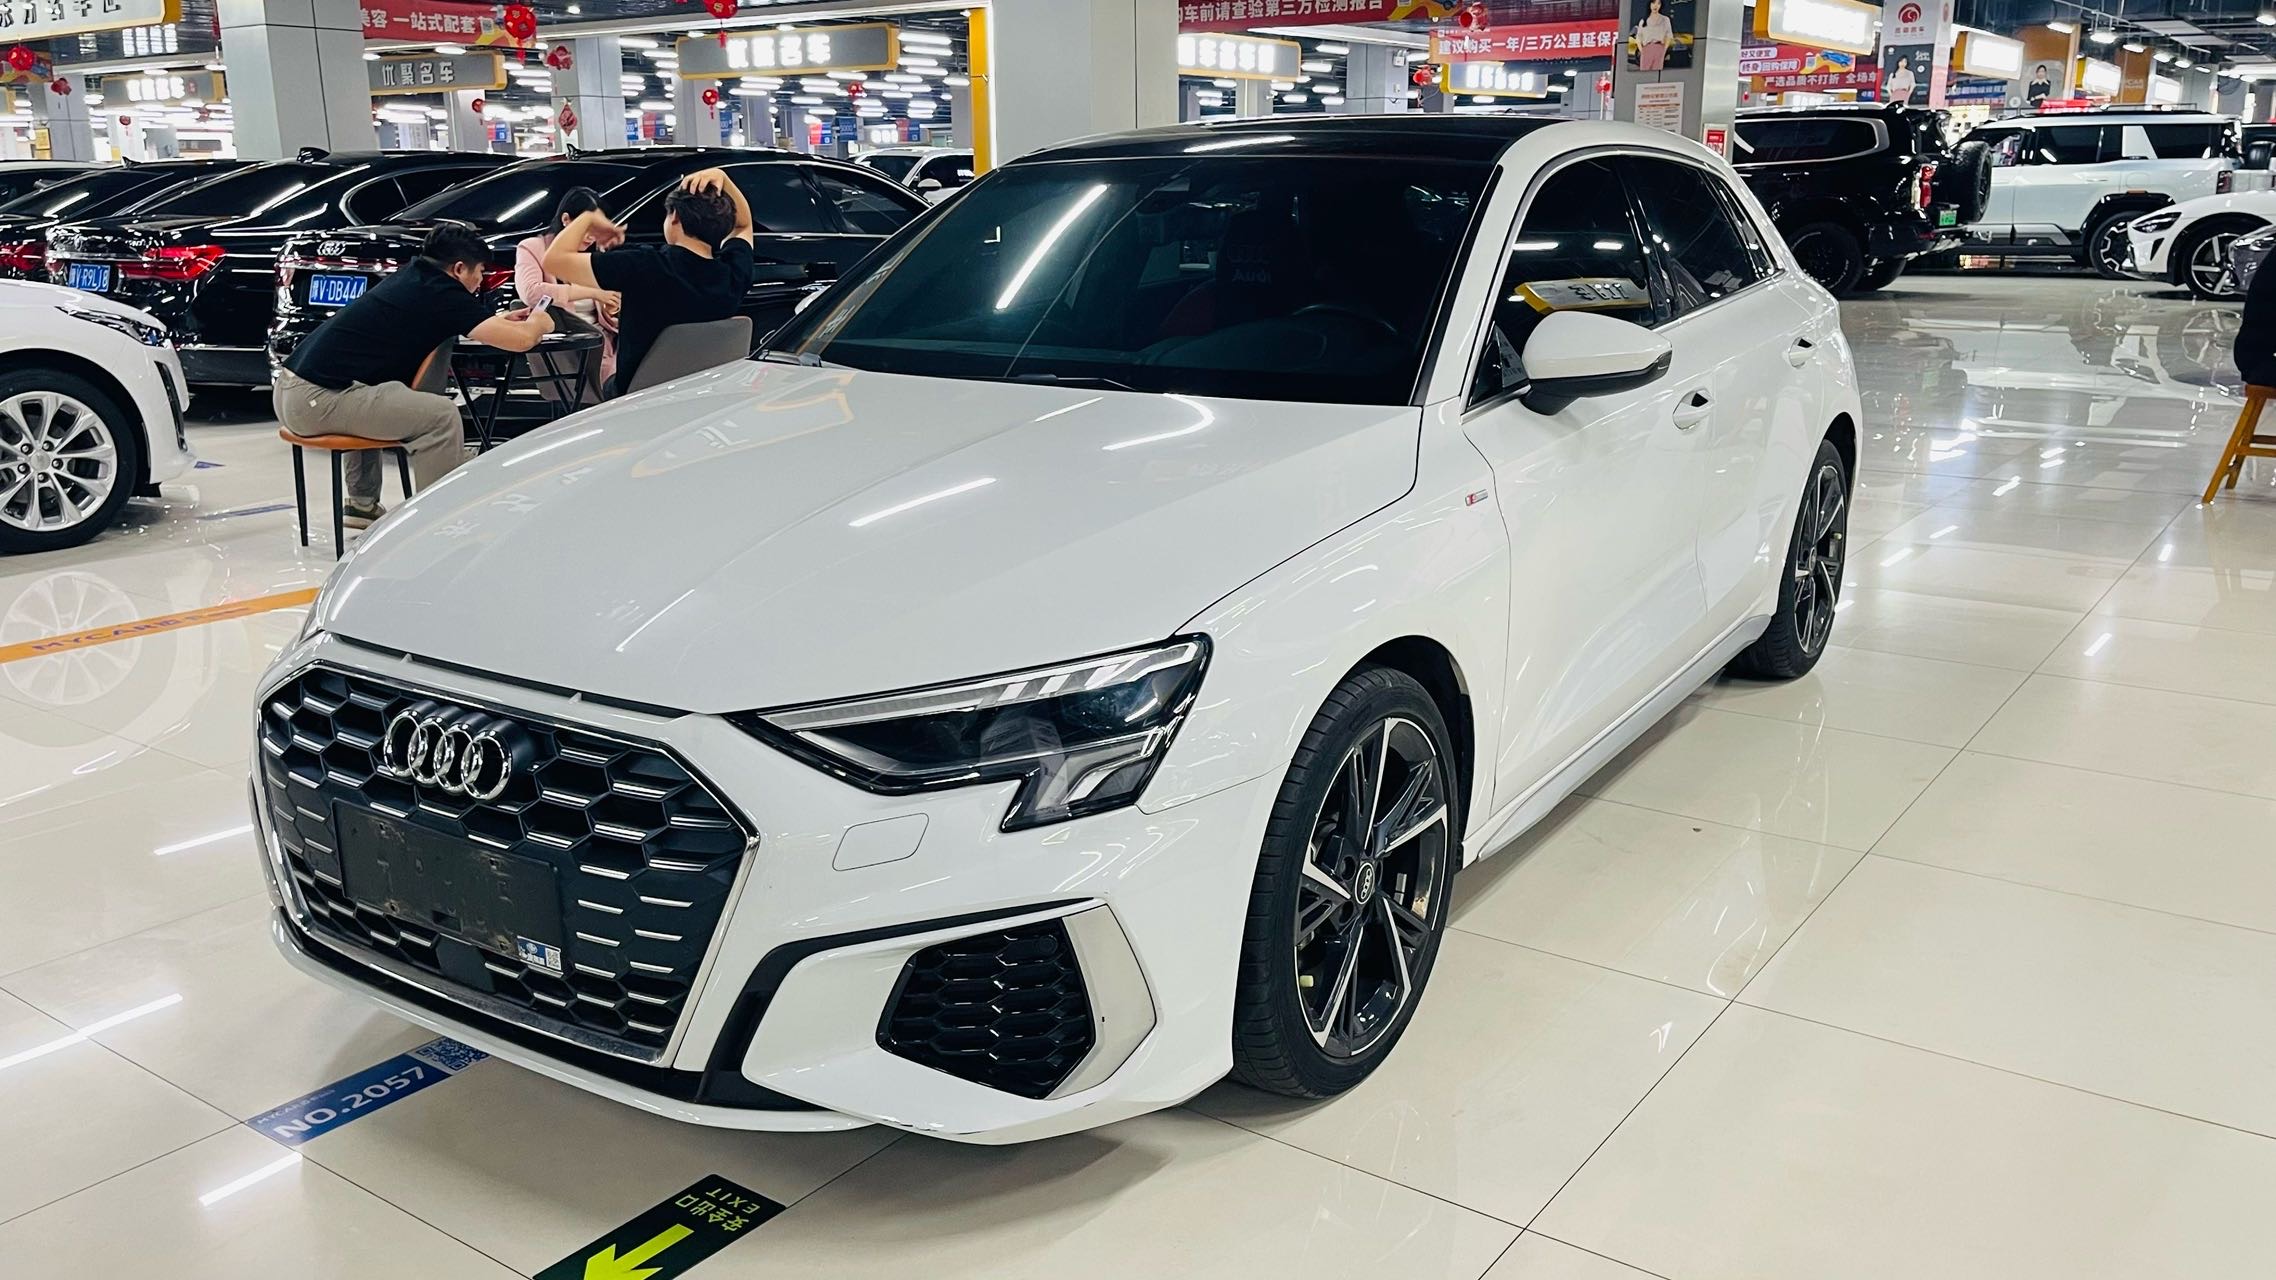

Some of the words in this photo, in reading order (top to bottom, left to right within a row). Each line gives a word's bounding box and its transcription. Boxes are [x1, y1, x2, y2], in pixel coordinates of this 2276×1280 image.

[381, 61, 454, 87] 优聚名车
[273, 1066, 425, 1138] NO.2057
[675, 1194, 749, 1232] 安全出口
[705, 1188, 760, 1214] EXIT
